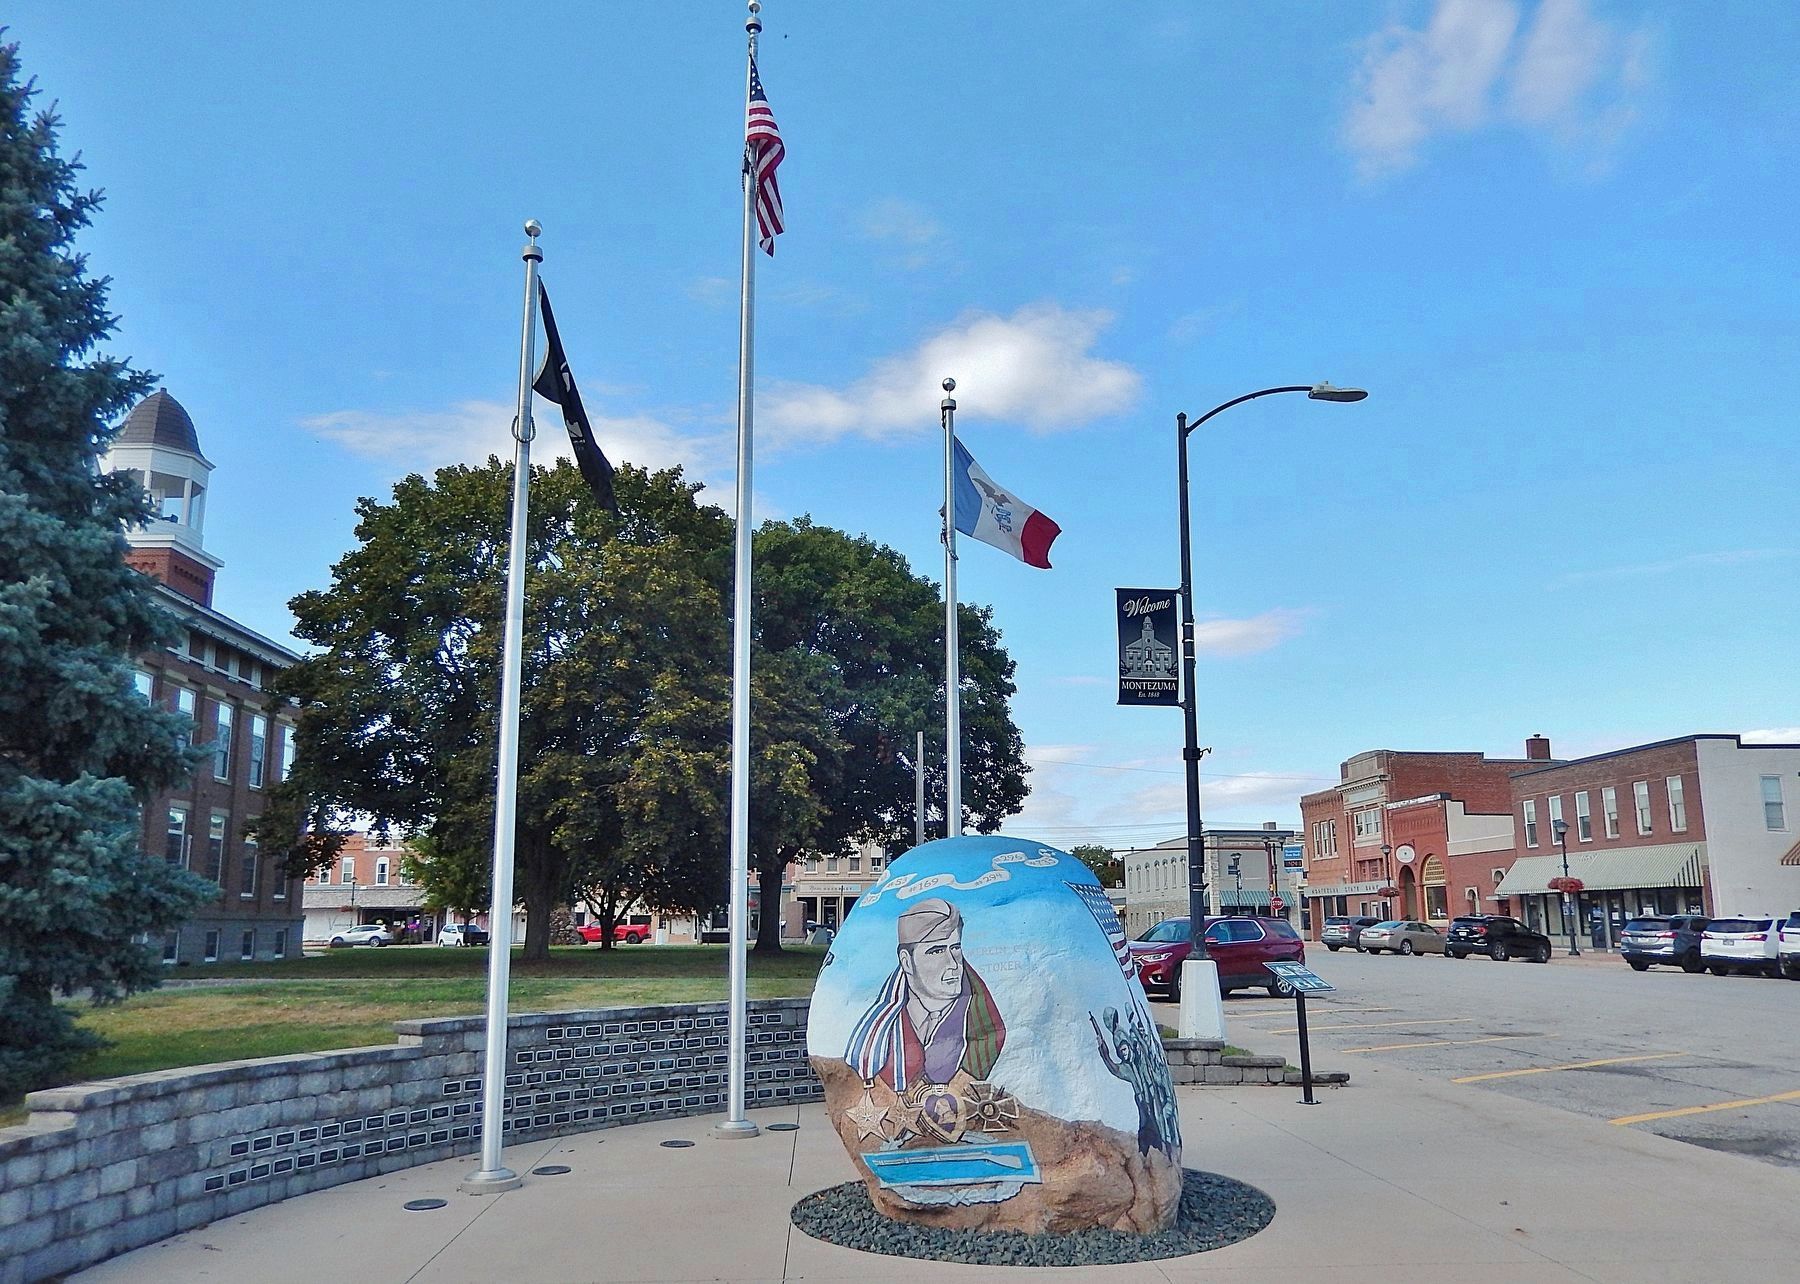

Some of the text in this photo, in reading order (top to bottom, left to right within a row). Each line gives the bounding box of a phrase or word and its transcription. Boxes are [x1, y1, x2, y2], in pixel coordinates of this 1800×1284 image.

[1122, 595, 1170, 618] Welcome
[1121, 680, 1177, 691] MONTEZUMA
[909, 878, 939, 893] #169
[978, 960, 1023, 973] STOKER
